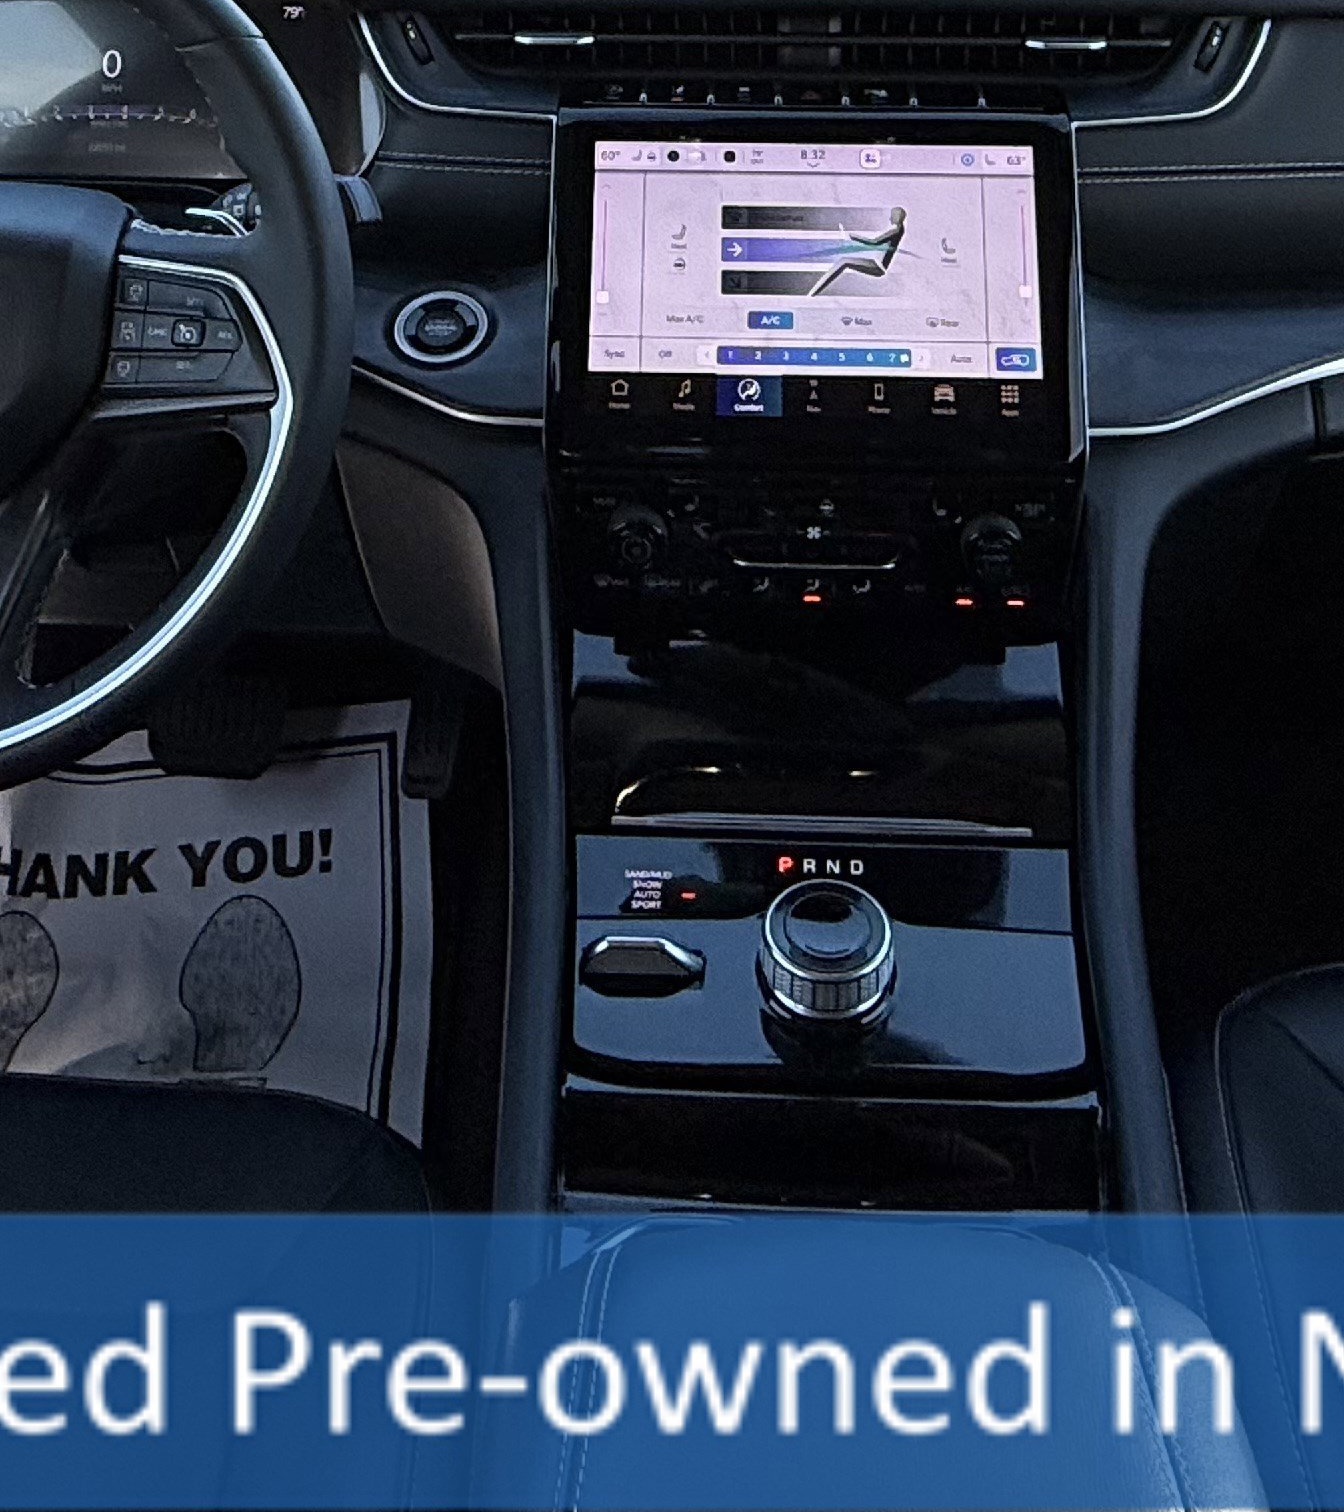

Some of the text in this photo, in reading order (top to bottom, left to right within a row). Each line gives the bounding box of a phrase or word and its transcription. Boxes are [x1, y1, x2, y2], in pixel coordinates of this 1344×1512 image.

[102, 50, 122, 78] 0
[760, 316, 781, 325] A/C
[179, 828, 333, 888] YOU!
[778, 856, 864, 875] P R N D
[634, 890, 662, 899] AUTO
